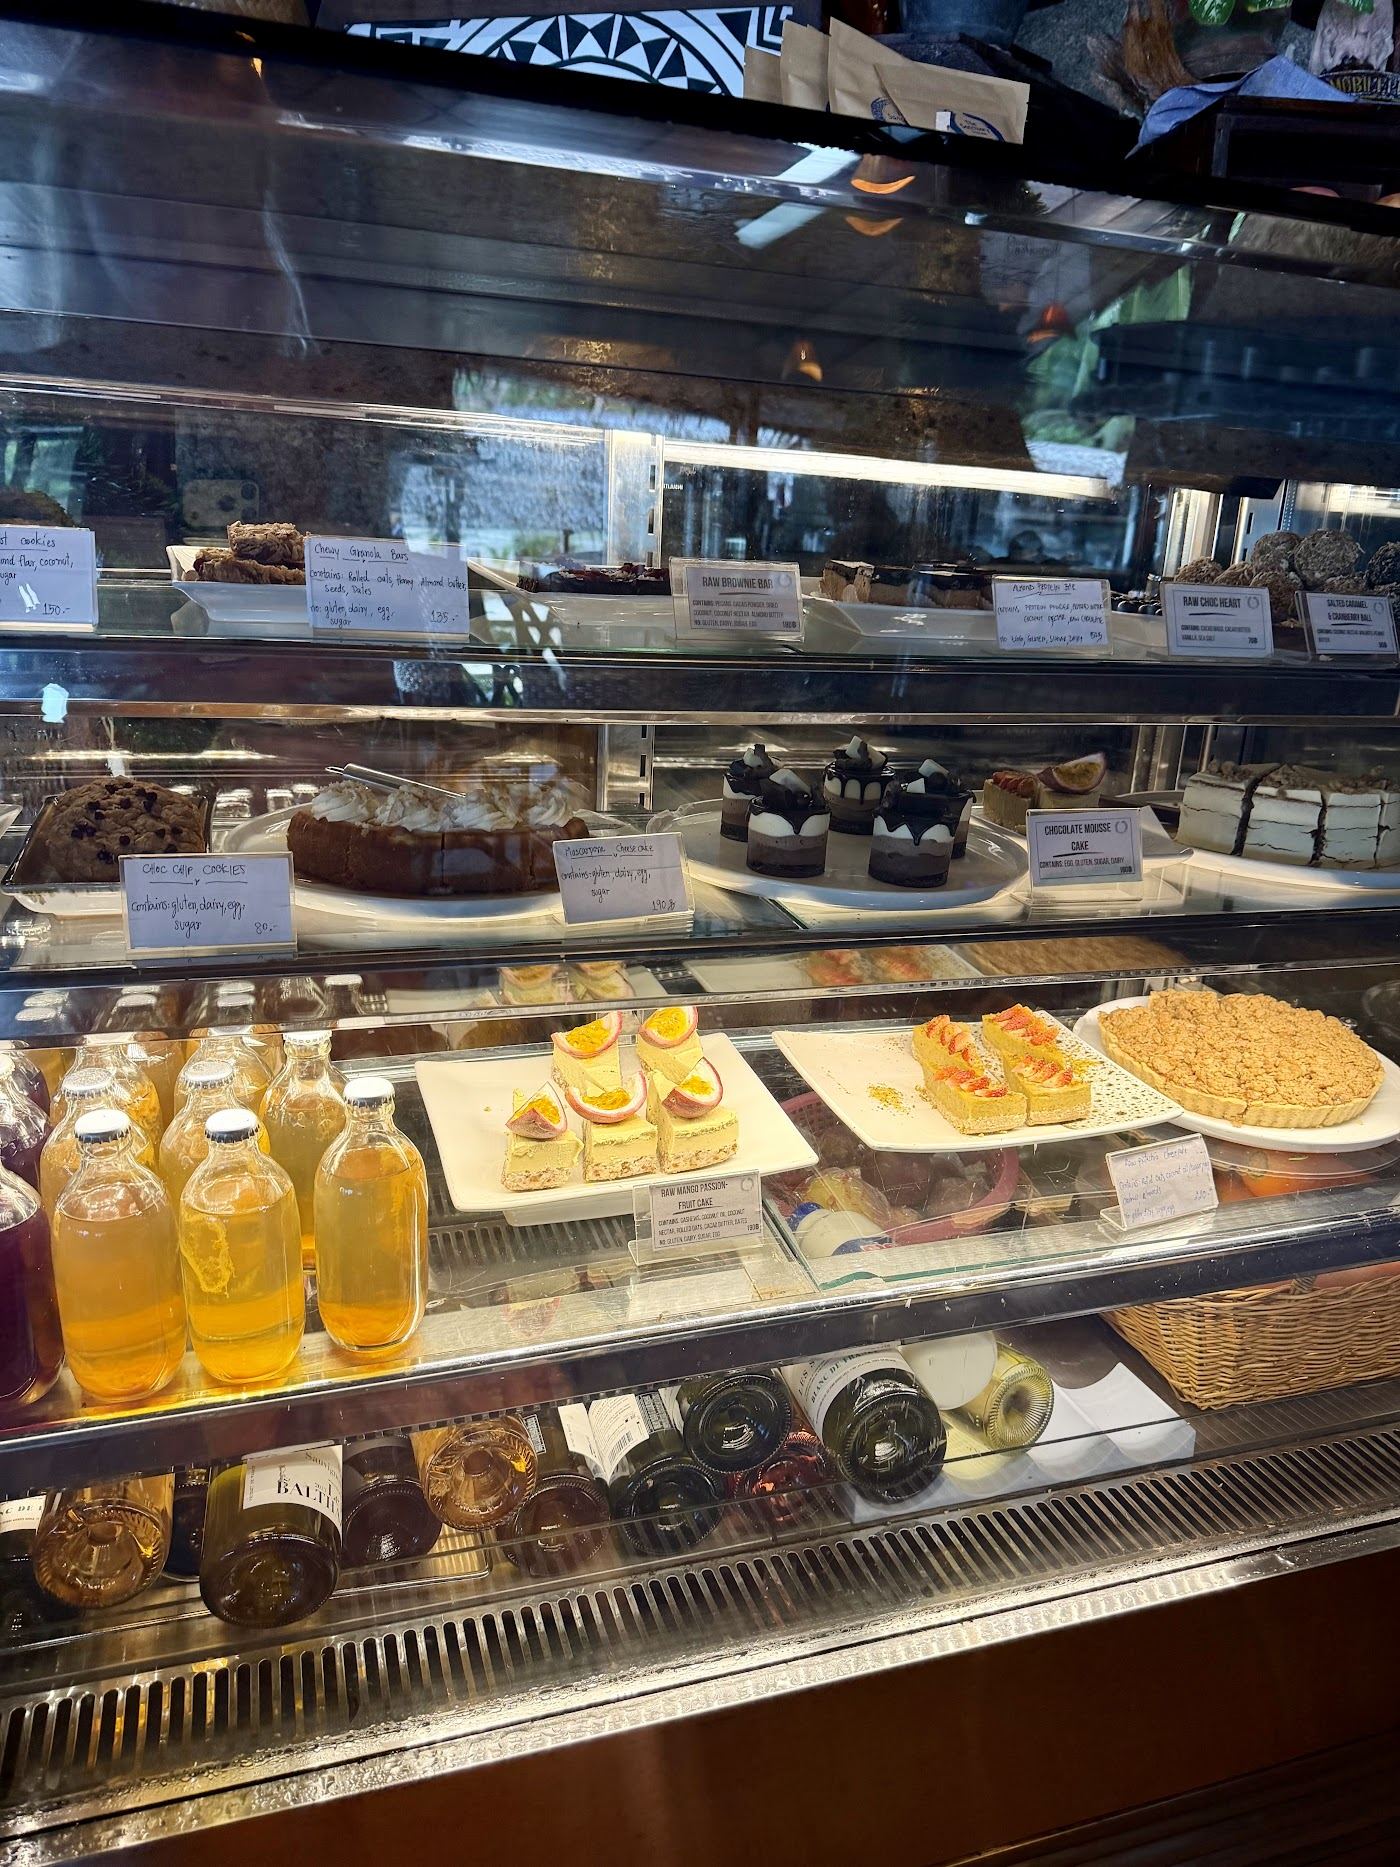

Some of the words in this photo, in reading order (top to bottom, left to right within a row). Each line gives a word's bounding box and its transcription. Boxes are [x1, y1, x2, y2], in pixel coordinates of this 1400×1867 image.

[20, 531, 56, 548] cookies
[314, 543, 340, 559] Chewy
[349, 545, 382, 560] Granola
[390, 549, 409, 561] Bars
[348, 571, 369, 583] Rolled
[702, 576, 720, 587] RAW
[721, 577, 757, 589] BROWNIE
[758, 578, 774, 589] BAR
[1183, 596, 1199, 607] RAW
[1200, 597, 1218, 608] CHOC
[1219, 598, 1241, 609] HEART
[1044, 824, 1083, 836] CHOCOLATE
[1084, 822, 1111, 834] MOUSSE
[1071, 840, 1089, 851] CAKE
[202, 863, 247, 876] COOKIES
[174, 919, 202, 938] sugar
[661, 1187, 676, 1198] RAW
[676, 1185, 699, 1196] MANGO
[700, 1181, 728, 1193] PASSION-
[678, 1200, 696, 1211] FRUIT
[697, 1198, 713, 1207] CAKE
